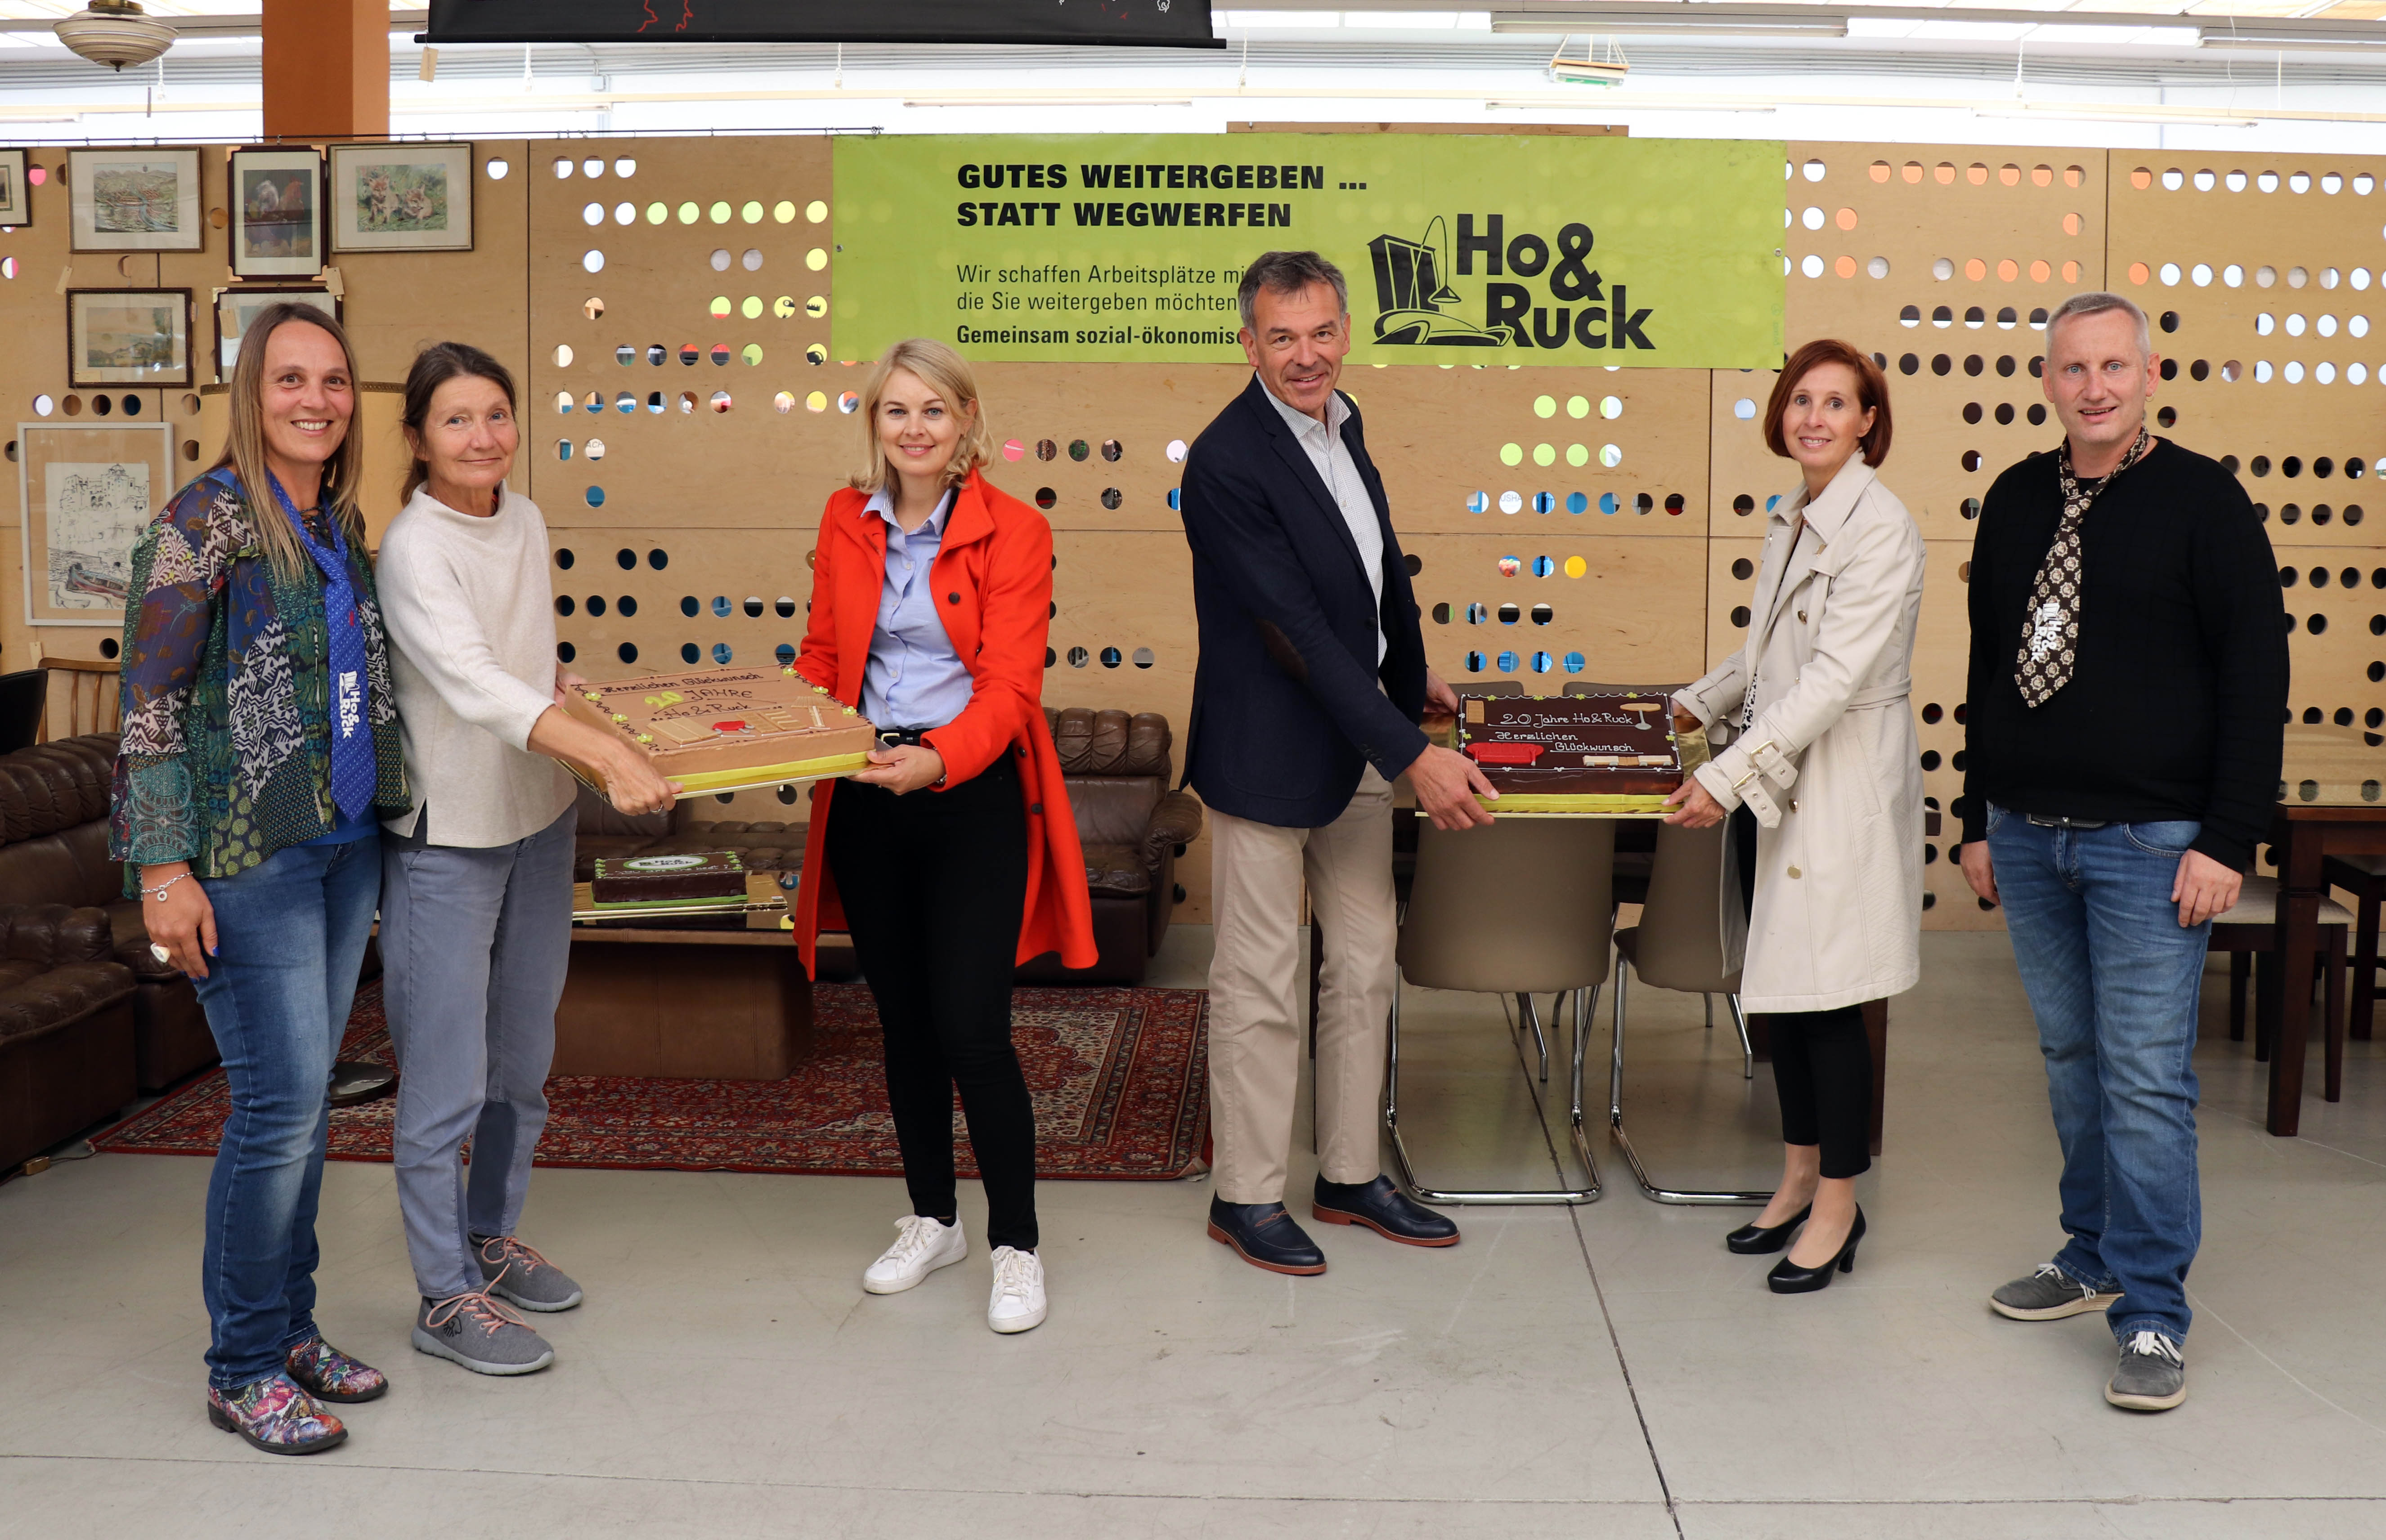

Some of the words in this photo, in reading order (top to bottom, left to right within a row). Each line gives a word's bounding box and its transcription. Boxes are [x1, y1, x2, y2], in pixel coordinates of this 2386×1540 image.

[958, 164, 1067, 189] GUTES
[1081, 164, 1323, 189] WEITERGEBEN
[957, 202, 1061, 227] STATT
[1073, 202, 1291, 227] WEGWERFEN
[1457, 213, 1605, 301] Ho&
[956, 264, 991, 283] Wir
[998, 264, 1080, 283] schaffen
[1088, 264, 1215, 286] Arbeitsplätze
[957, 291, 983, 310] die
[992, 291, 1020, 310] Sie
[1027, 292, 1147, 315] weitergeben
[1156, 291, 1237, 311] möchten
[1486, 282, 1656, 350] Ruck
[957, 325, 1069, 344] Gemeinsam
[682, 672, 764, 685] Glückwunsch
[645, 691, 684, 708] 20
[1500, 713, 1532, 725] 20
[1533, 714, 1570, 729] Jahre
[1494, 731, 1579, 741] Herzlichen
[1554, 742, 1635, 752] Glückwunsch
